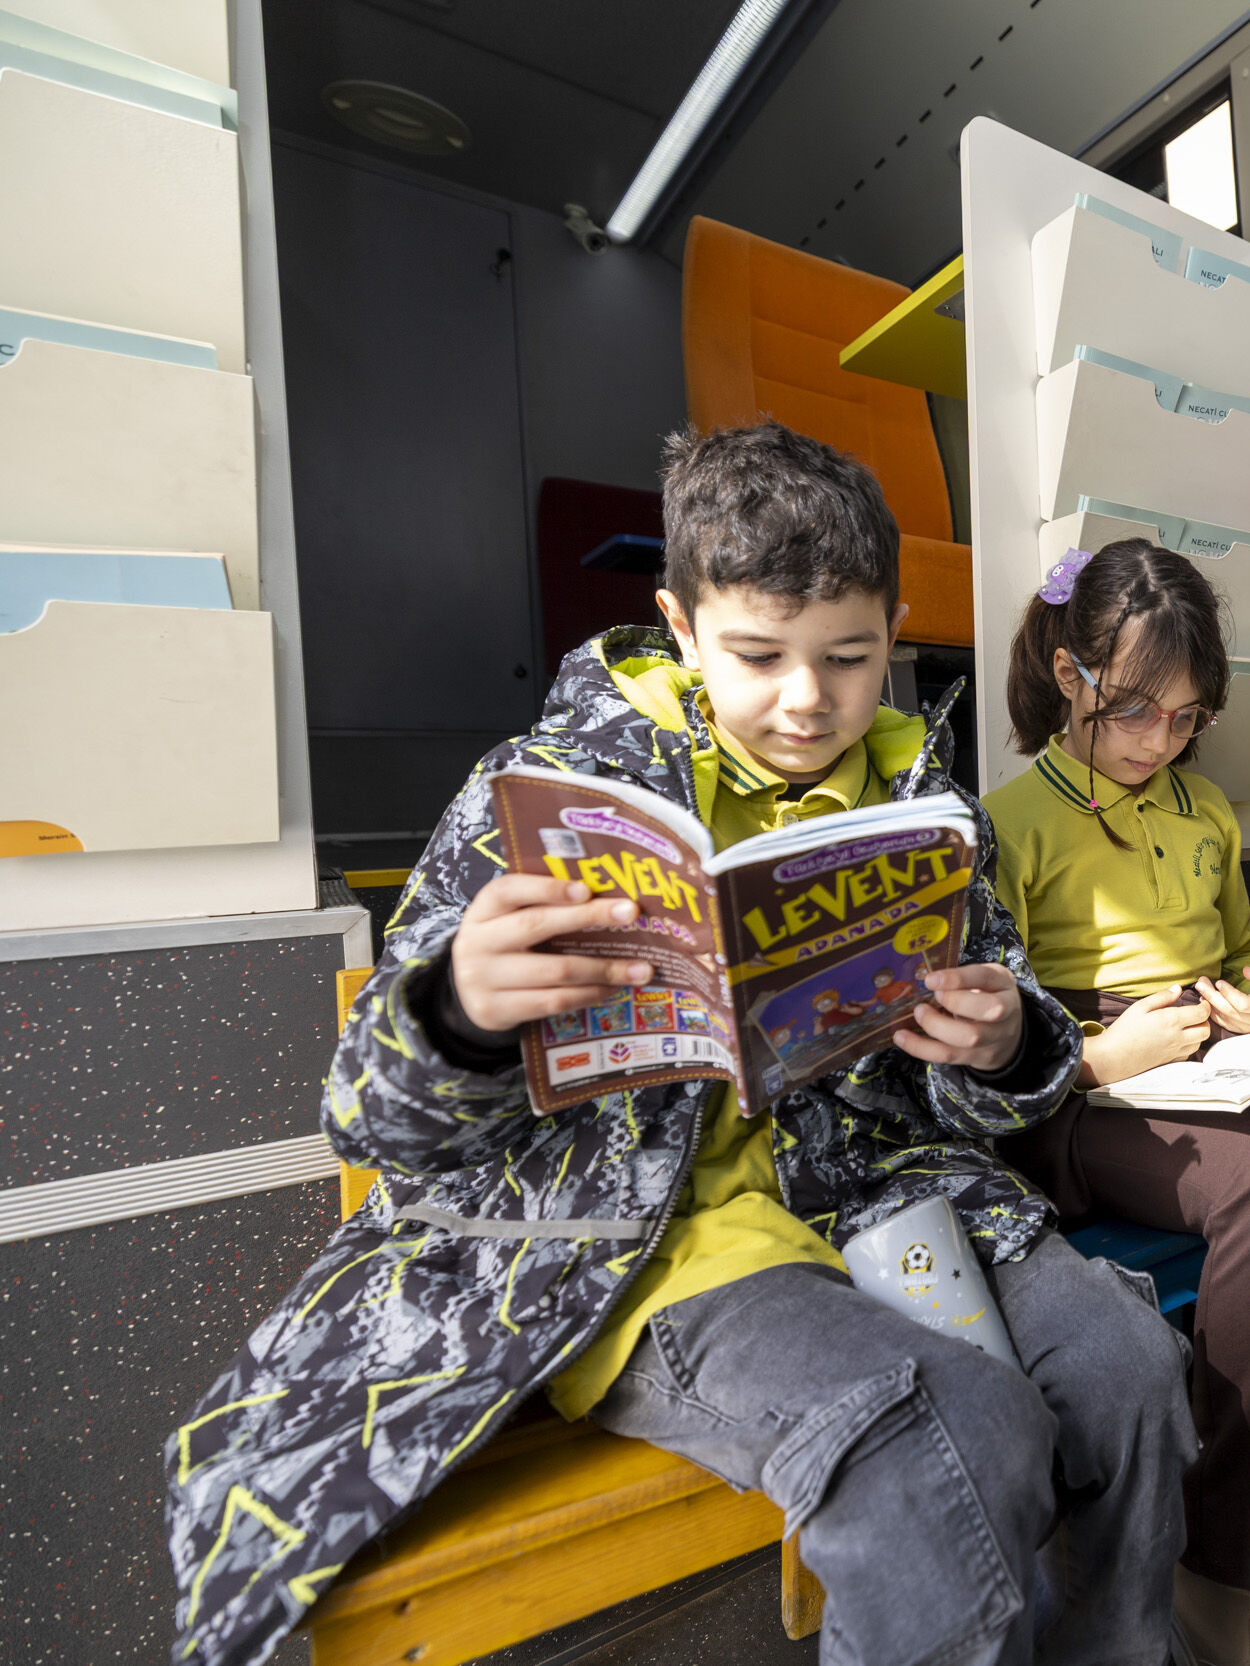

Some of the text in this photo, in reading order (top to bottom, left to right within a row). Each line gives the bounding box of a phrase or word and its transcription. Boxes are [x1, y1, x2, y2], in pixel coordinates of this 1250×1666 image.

[543, 850, 702, 923] LEVENT
[742, 847, 953, 951] LEVENT
[795, 900, 921, 962] ADANA'DA
